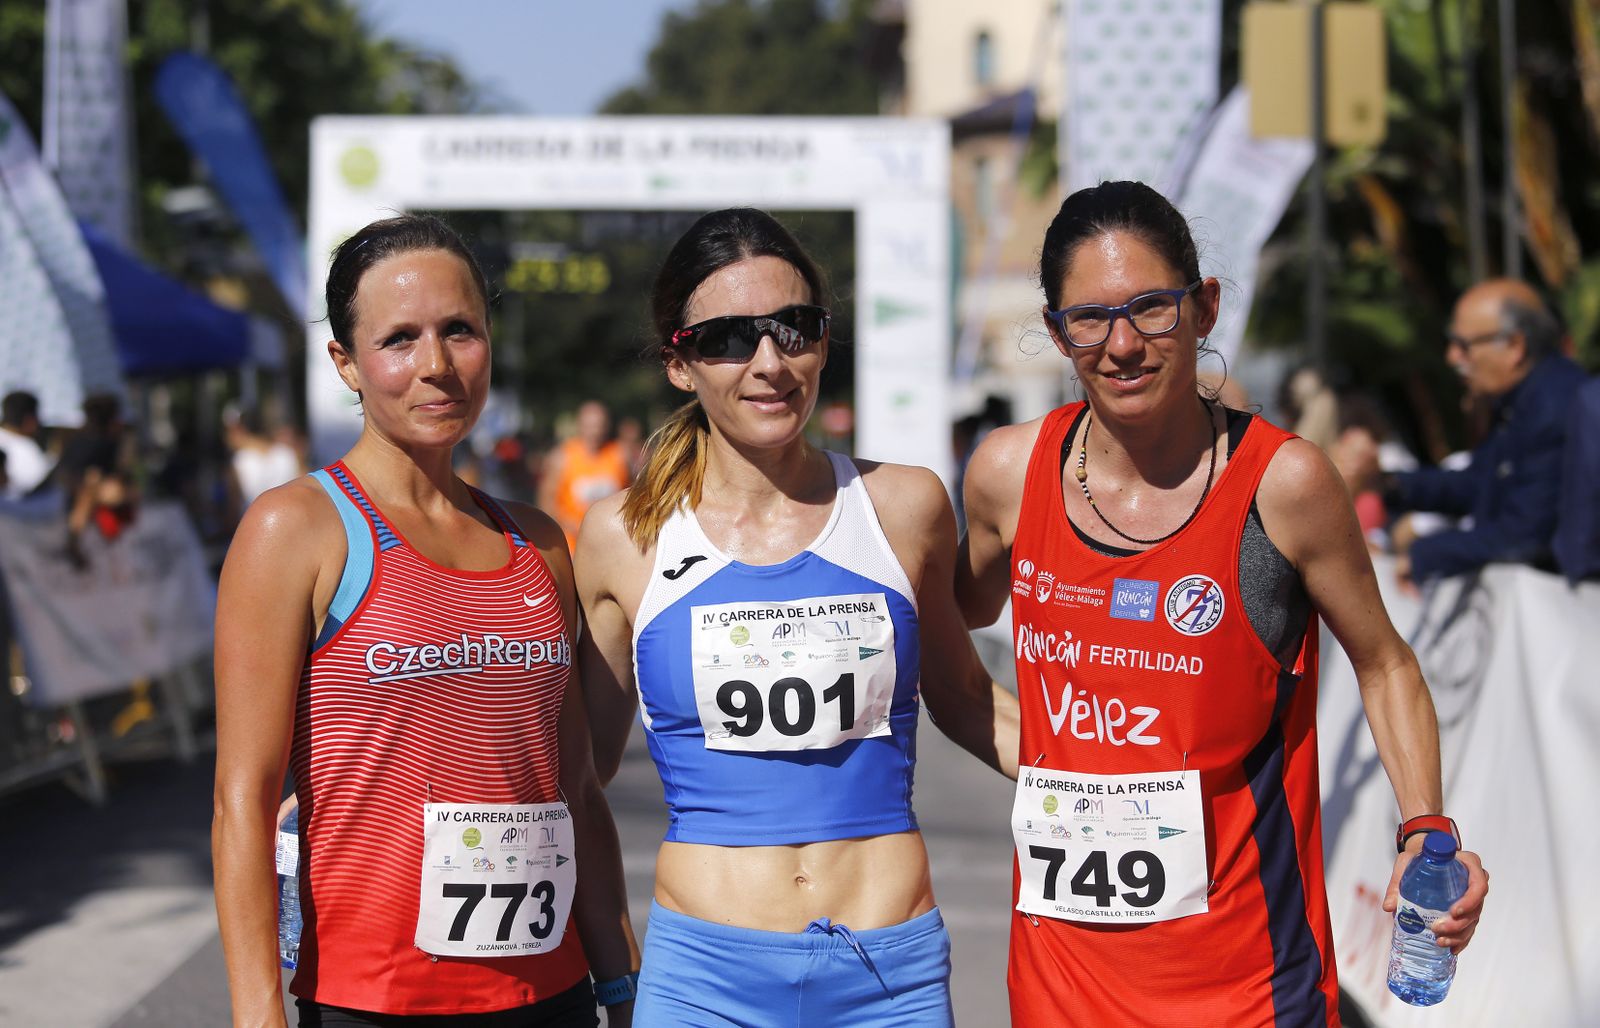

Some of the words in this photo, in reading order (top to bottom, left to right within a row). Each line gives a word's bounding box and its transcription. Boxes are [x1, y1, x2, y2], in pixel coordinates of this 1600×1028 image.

[1056, 582, 1106, 596] Ayuntamiento
[1055, 591, 1104, 607] Vélez-Málaga
[703, 613, 716, 624] IV
[719, 608, 785, 623] CARRERA
[787, 607, 805, 618] DE
[808, 605, 827, 617] LA
[829, 601, 877, 615] PRENSA
[771, 622, 807, 640] APM
[1089, 644, 1204, 676] FERTILIDAD
[716, 673, 855, 737] 901
[1040, 672, 1161, 746] Vélez
[1024, 777, 1034, 787] IV
[1036, 778, 1085, 794] CARRERA
[1087, 784, 1104, 795] DE
[1108, 783, 1125, 795] LA
[1128, 780, 1185, 794] PRENSA
[1073, 798, 1104, 814] APM
[437, 811, 450, 822] IV
[453, 811, 514, 823] CARRERA
[516, 812, 530, 823] DE
[532, 811, 544, 822] LA
[544, 809, 569, 821] PRENSA
[500, 827, 528, 844] APM
[1028, 845, 1166, 908] 749
[442, 880, 556, 942] 773
[1054, 905, 1084, 916] VELASCO
[1085, 909, 1123, 918] CASTILLO,
[1125, 909, 1156, 917] TERESA
[522, 941, 542, 949] TEREZA
